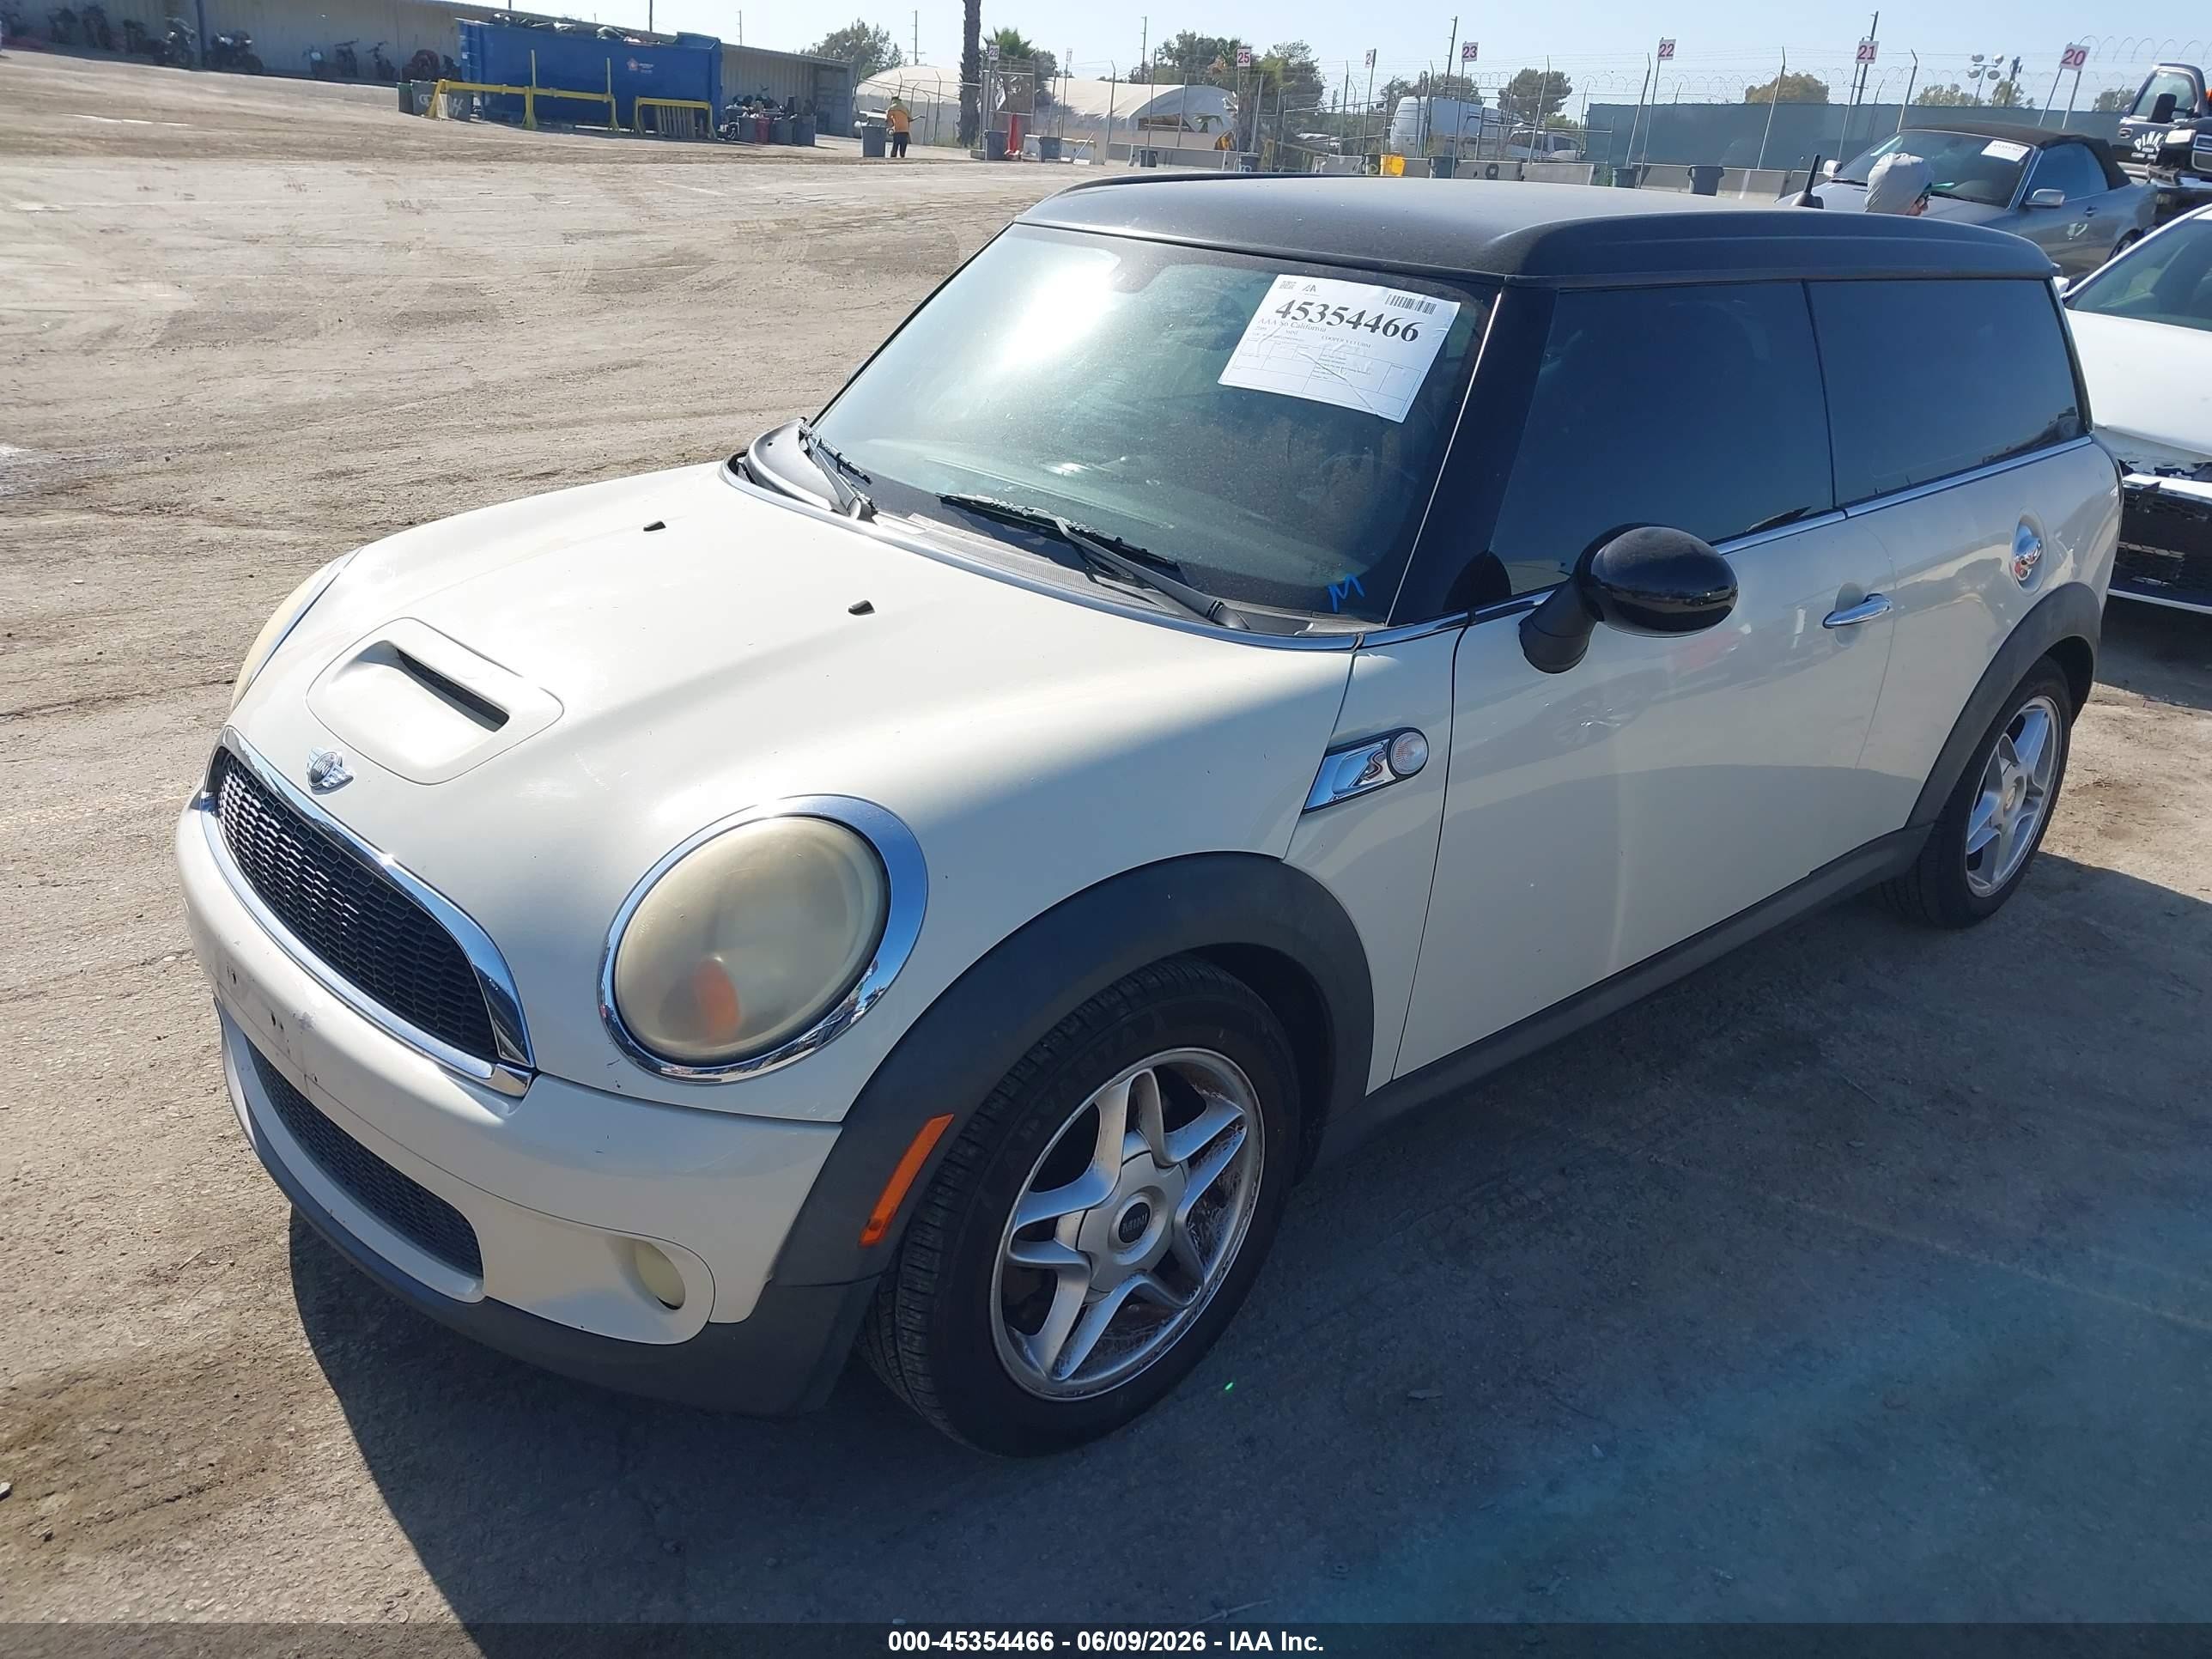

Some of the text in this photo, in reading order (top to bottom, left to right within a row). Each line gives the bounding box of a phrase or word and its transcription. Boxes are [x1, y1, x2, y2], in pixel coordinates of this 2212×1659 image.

[1462, 46, 1477, 58] 23
[1658, 43, 1674, 57] 22
[1856, 45, 1875, 59] 21
[2061, 48, 2086, 66] 20
[1237, 52, 1249, 63] 25
[1275, 300, 1425, 342] 45354466
[1291, 321, 1327, 333] California
[1121, 1212, 1148, 1234] MINI
